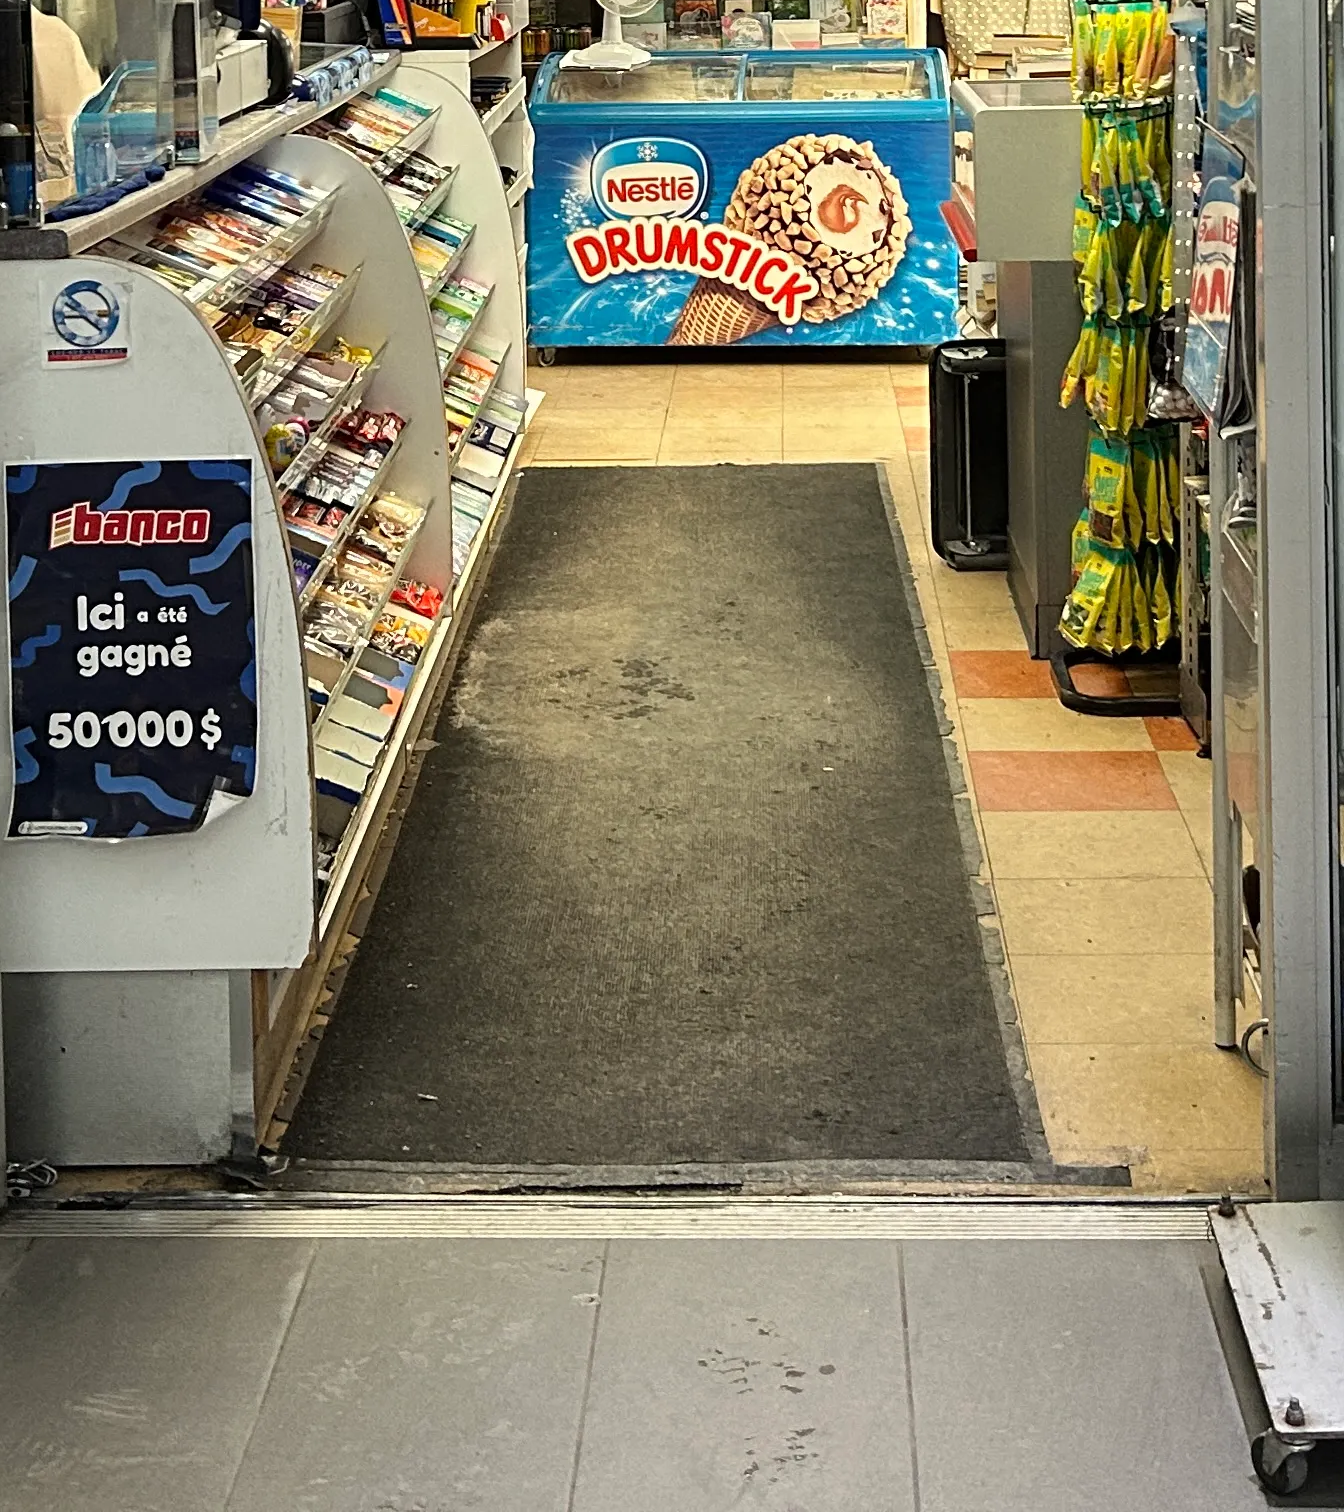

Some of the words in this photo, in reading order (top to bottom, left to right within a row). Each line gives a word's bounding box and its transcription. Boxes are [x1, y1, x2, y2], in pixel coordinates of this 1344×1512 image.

[607, 174, 695, 203] Nestlé
[572, 220, 814, 320] DRUMSTICK
[72, 502, 210, 549] banco
[77, 592, 125, 632] Ici
[137, 609, 148, 623] a
[157, 605, 188, 623] été
[77, 635, 191, 677] gagné
[201, 707, 222, 751] $
